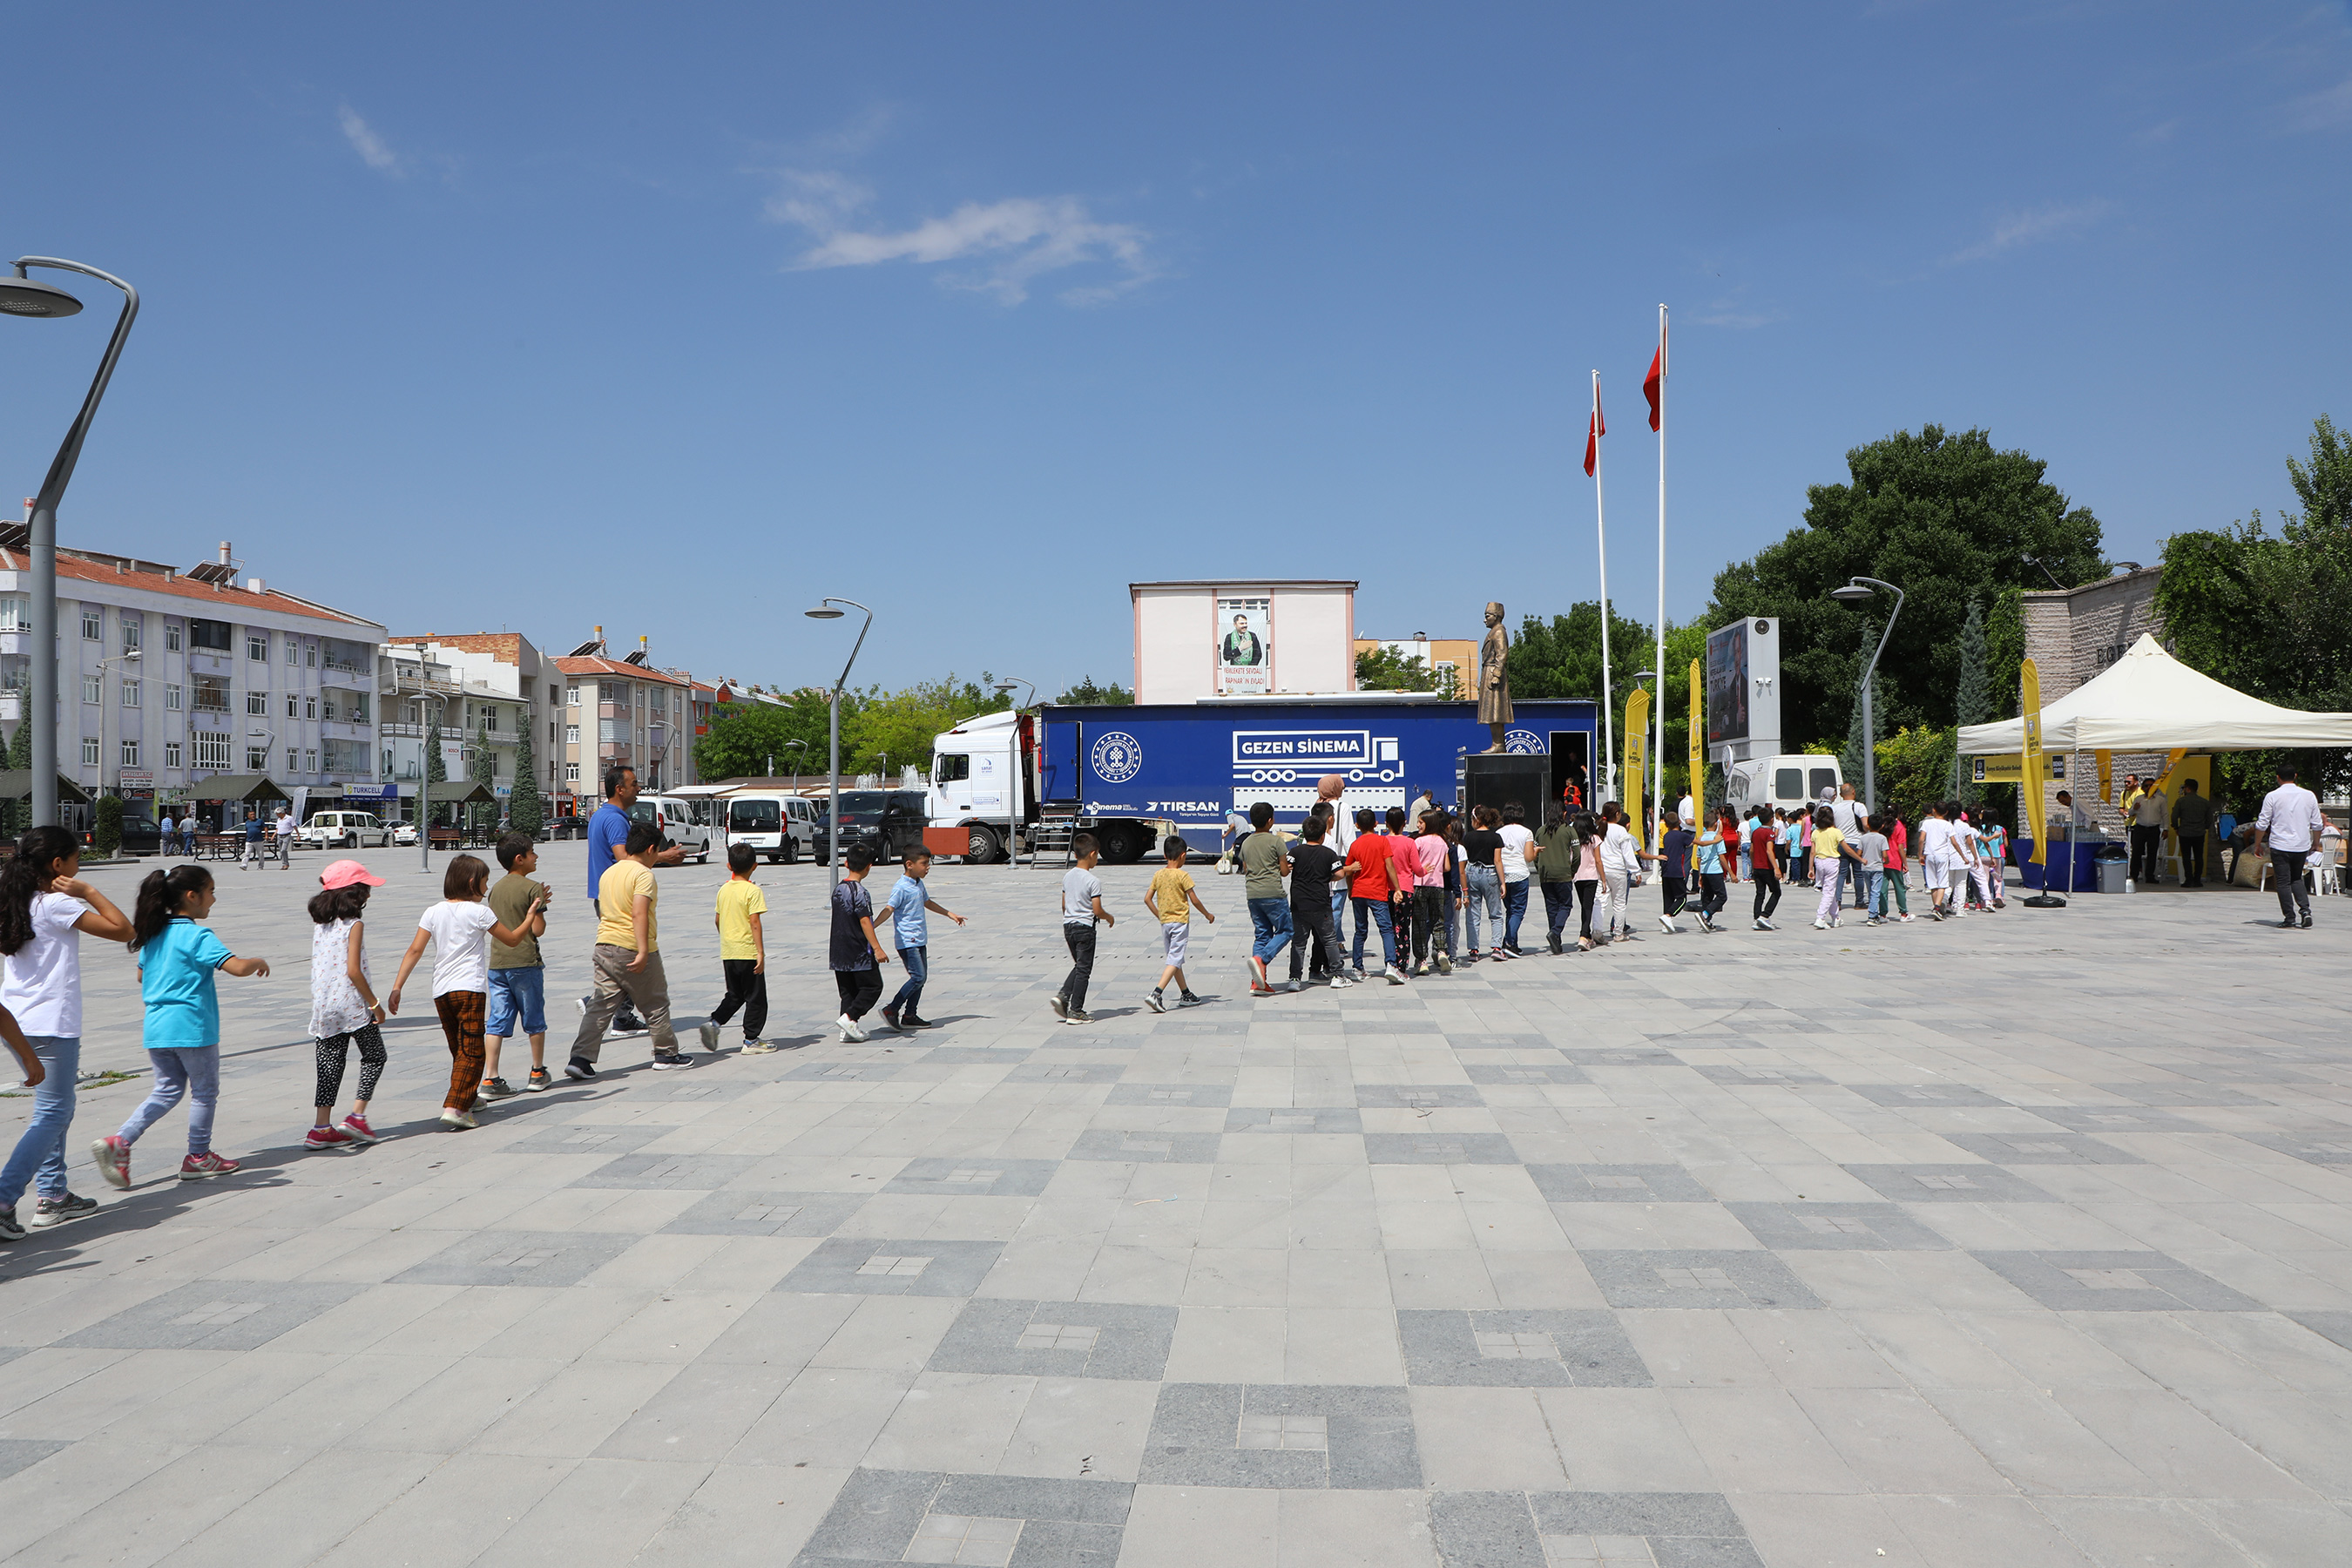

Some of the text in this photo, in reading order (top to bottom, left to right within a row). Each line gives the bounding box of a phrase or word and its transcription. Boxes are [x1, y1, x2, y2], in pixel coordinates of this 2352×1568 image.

[1241, 738, 1361, 754] GEZEN SİNEMA
[1091, 802, 1123, 812] Sinema
[1160, 801, 1220, 812] TIRSAN
